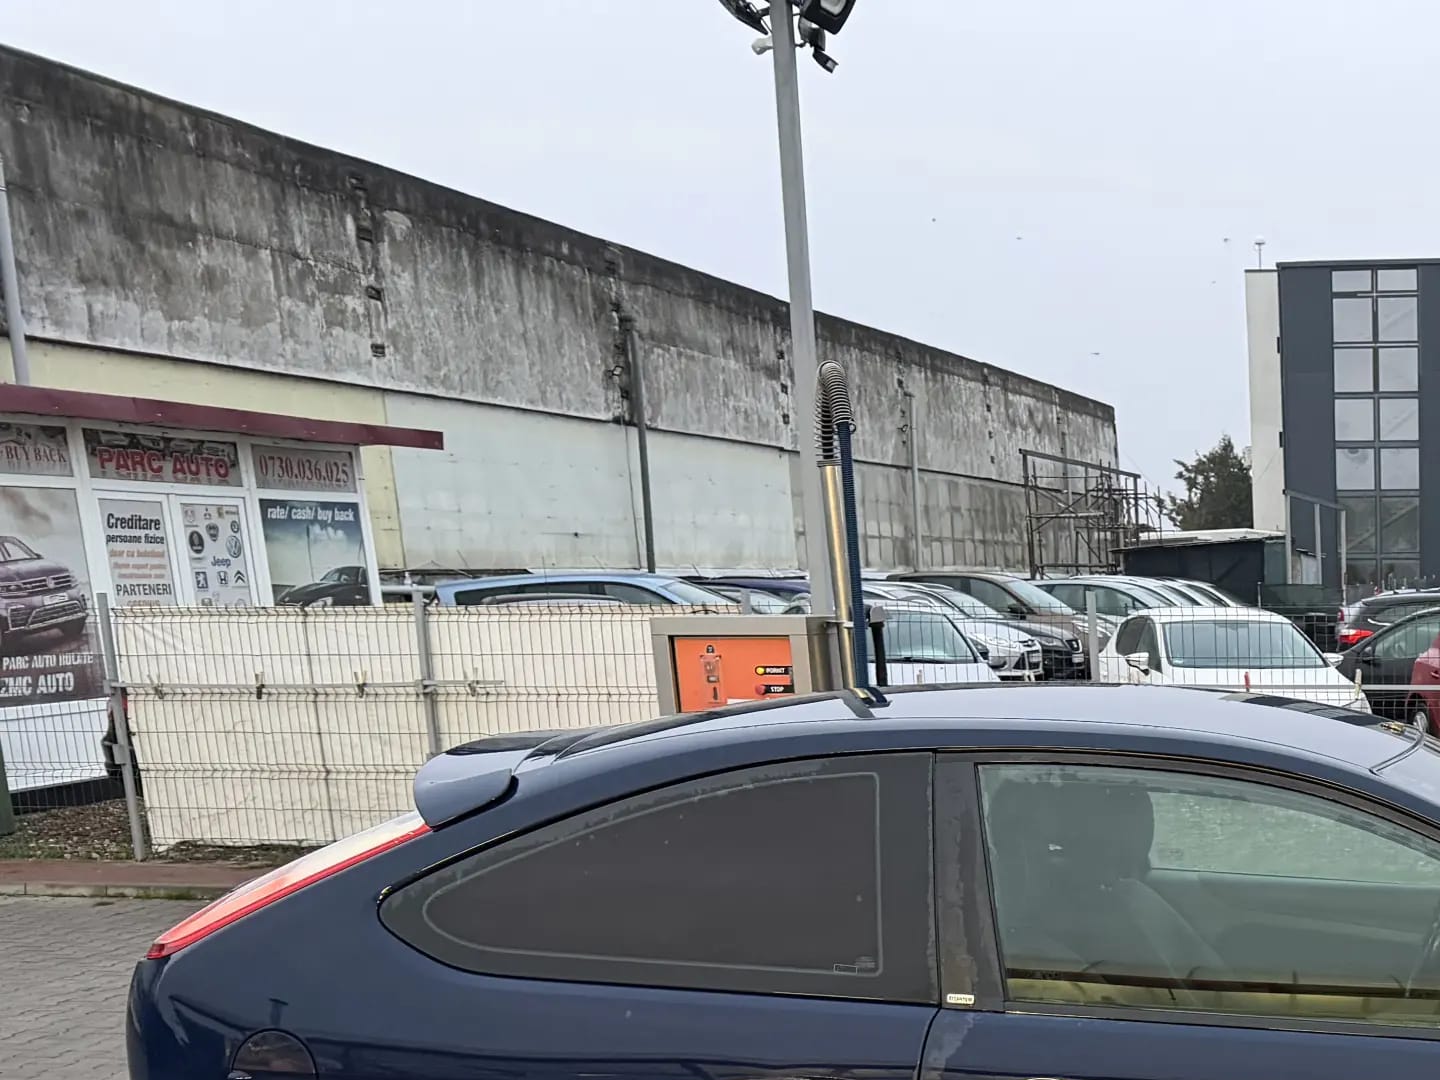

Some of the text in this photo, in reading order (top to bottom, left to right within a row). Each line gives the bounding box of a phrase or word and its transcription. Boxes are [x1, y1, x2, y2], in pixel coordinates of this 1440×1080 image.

[5, 445, 68, 463] BUY BACK
[96, 446, 230, 479] PARC AUTO
[259, 454, 350, 484] 0730.036.025
[106, 512, 161, 531] Creditare
[317, 507, 333, 523] buy
[334, 507, 355, 522] back
[105, 533, 165, 545] persoane fizice
[211, 556, 232, 569] Jeep
[115, 583, 173, 597] PARTENERI
[2, 656, 29, 671] PARC
[31, 654, 57, 669] AUTO
[36, 671, 75, 695] AUTO
